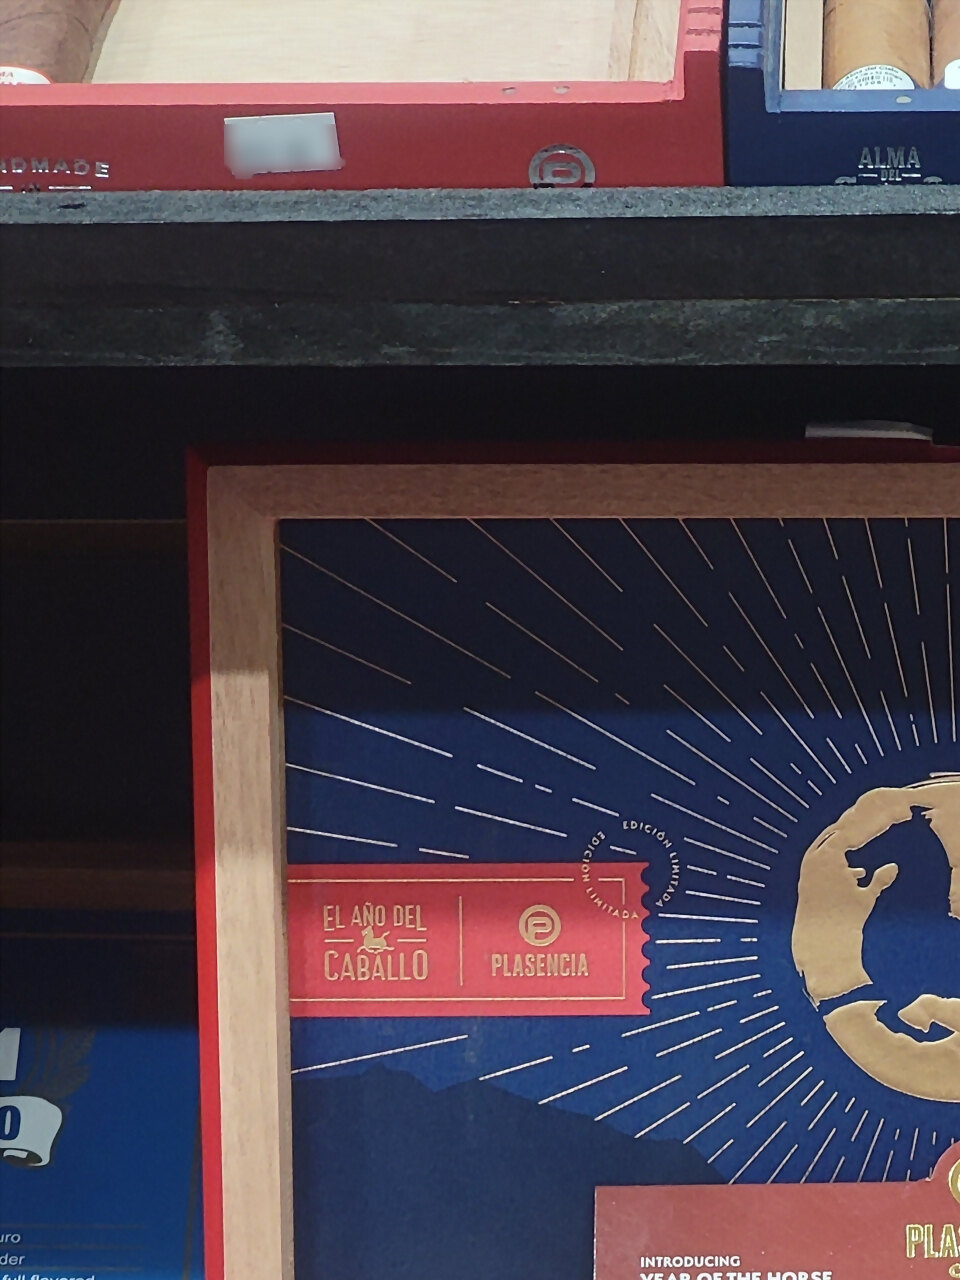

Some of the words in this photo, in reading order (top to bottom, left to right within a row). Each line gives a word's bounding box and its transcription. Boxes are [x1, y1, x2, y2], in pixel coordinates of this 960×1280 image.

[858, 146, 921, 168] ALMA
[880, 169, 902, 181] DEL
[655, 851, 681, 908] LIMITADA
[323, 903, 346, 932] EL
[351, 902, 386, 927] AÑO
[393, 904, 428, 931] DEL
[324, 949, 429, 981] CABALLO
[490, 953, 589, 977] PLASENCIA
[640, 1255, 741, 1268] INTRODUCING
